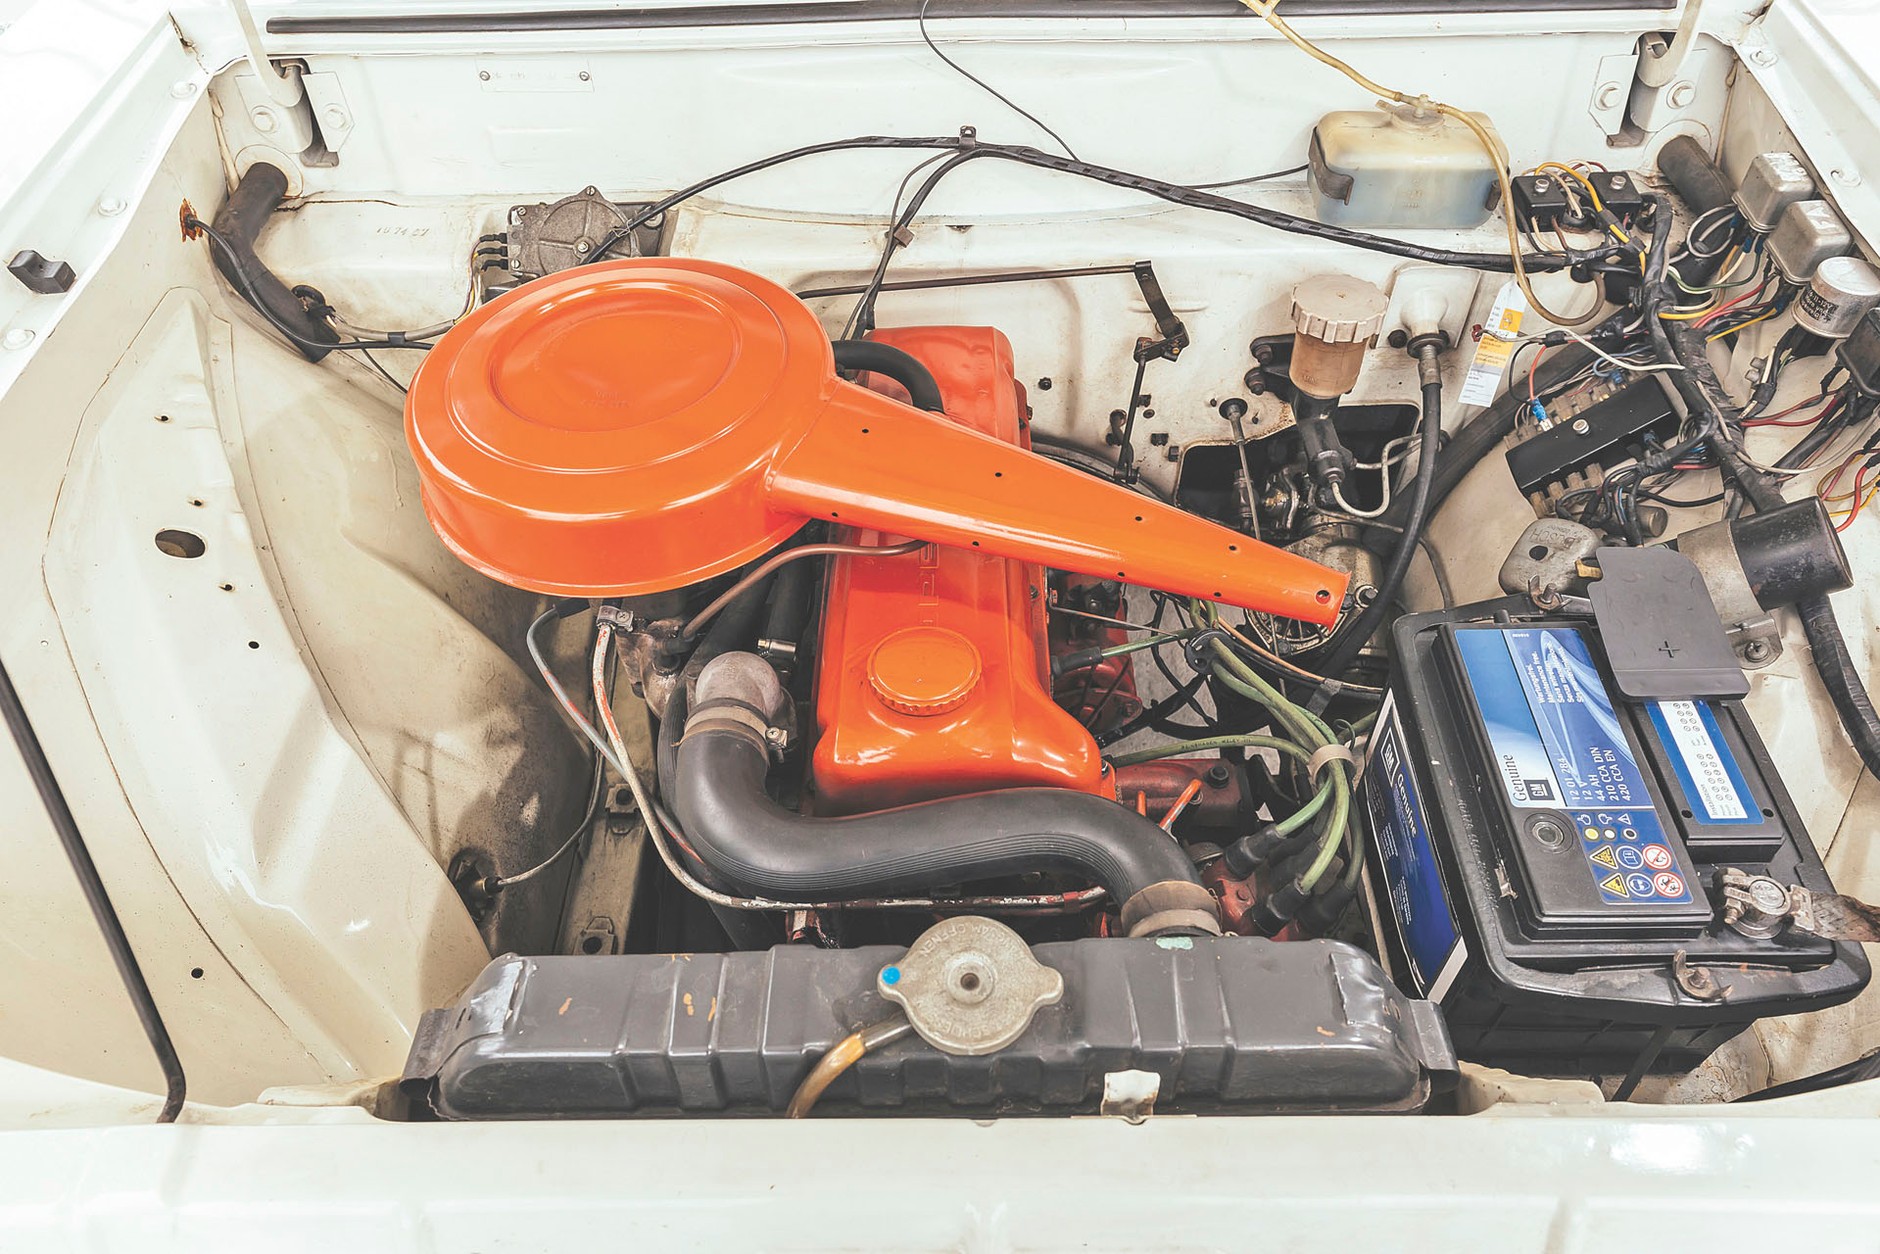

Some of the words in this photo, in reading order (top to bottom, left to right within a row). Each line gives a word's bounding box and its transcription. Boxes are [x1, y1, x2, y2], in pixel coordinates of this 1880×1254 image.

[1384, 743, 1395, 773] GM
[1589, 746, 1604, 763] DIN
[1603, 749, 1616, 762] EN
[1557, 758, 1571, 774] 284
[1597, 765, 1611, 783] CCA
[1610, 764, 1624, 782] CCA
[1503, 754, 1528, 801] Genuine
[1564, 777, 1576, 788] 01
[1588, 774, 1601, 787] AH
[1529, 783, 1548, 797] GM
[1570, 789, 1581, 801] 12
[1582, 789, 1594, 800] 12
[1594, 790, 1606, 801] 44
[1605, 785, 1619, 801] 210
[1617, 784, 1631, 801] 420
[1397, 773, 1418, 839] Genuine
[1700, 784, 1718, 816] Installation
